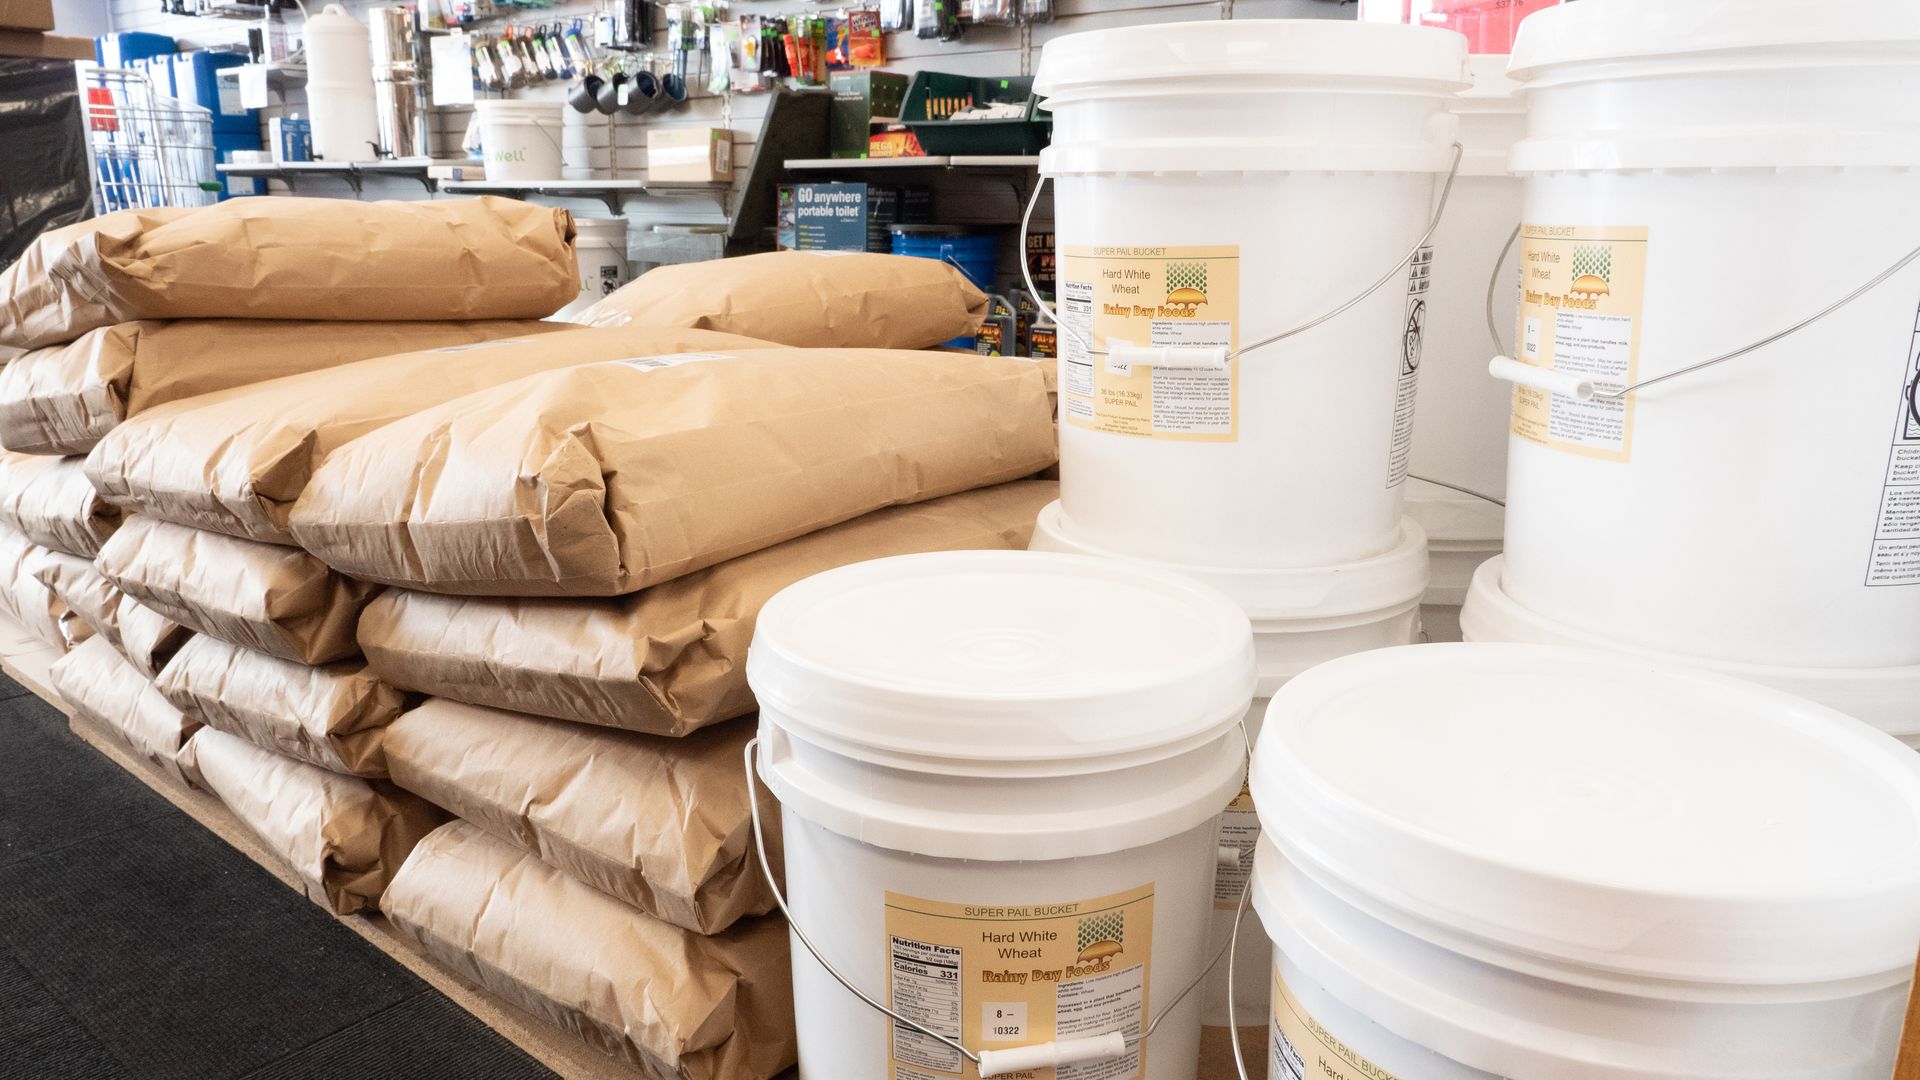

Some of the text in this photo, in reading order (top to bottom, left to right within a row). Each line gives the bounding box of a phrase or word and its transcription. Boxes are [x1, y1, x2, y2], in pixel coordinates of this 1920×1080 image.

[798, 187, 862, 205] GO anywhere
[798, 206, 859, 219] portable toilet
[1548, 226, 1576, 236] BUCKET
[1028, 235, 1043, 249] GET
[1094, 248, 1166, 256] SUPER PAIL BUCKET
[1528, 250, 1560, 264] Hard White
[1102, 269, 1150, 280] Hard White
[1532, 268, 1551, 280] Wheat
[1112, 284, 1140, 294] Wheat
[1544, 293, 1561, 309] Day
[1563, 294, 1596, 310] Foods
[1104, 304, 1196, 319] Rainy Day Foods
[1104, 398, 1138, 408] SUPER PAIL
[964, 904, 1079, 918] SUPER PAIL BUCKET
[982, 930, 1058, 943] Hard White
[892, 936, 960, 955] Nutrition Facts
[998, 946, 1042, 959] Wheat
[894, 962, 958, 980] Calories 331
[982, 960, 1110, 985] Rainy Day Foods
[996, 1010, 1002, 1018] 8
[993, 1026, 1020, 1035] 10322
[1308, 1016, 1336, 1048] SUPER
[1338, 1044, 1358, 1066] PAIL
[1318, 1056, 1344, 1080] Hard
[1016, 1072, 1035, 1080] PAIL
